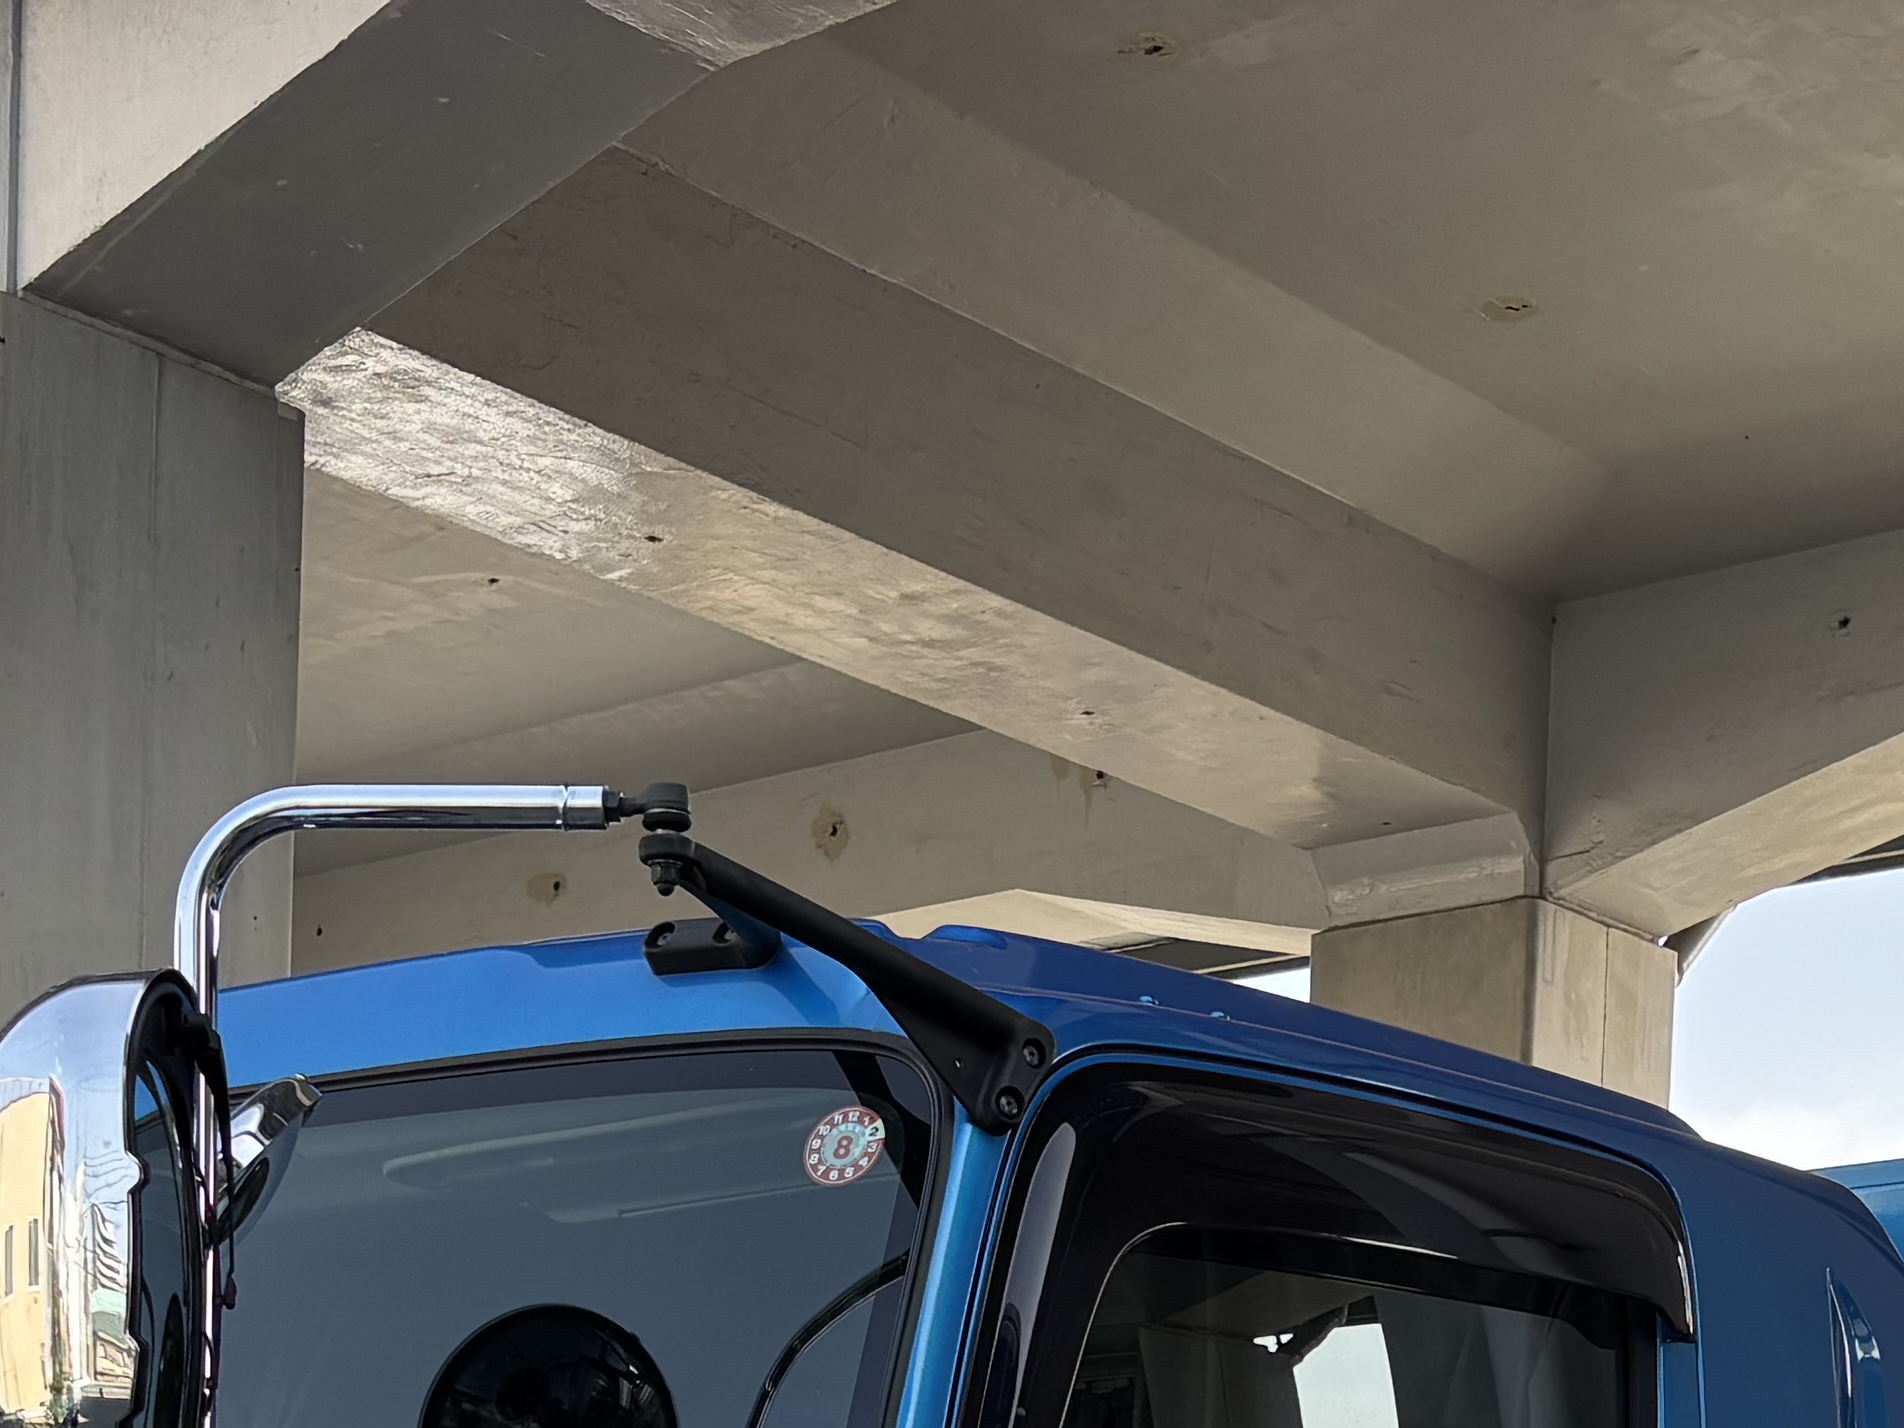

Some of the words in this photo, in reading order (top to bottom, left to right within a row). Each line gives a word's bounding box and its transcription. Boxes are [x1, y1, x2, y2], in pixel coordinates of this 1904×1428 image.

[869, 1126, 880, 1137] 2
[811, 1139, 821, 1150] 9
[833, 1135, 854, 1160] 8
[867, 1142, 878, 1153] 3
[809, 1153, 819, 1165] 8
[816, 1165, 827, 1176] 7
[829, 1169, 839, 1181] 6
[844, 1167, 854, 1178] 5
